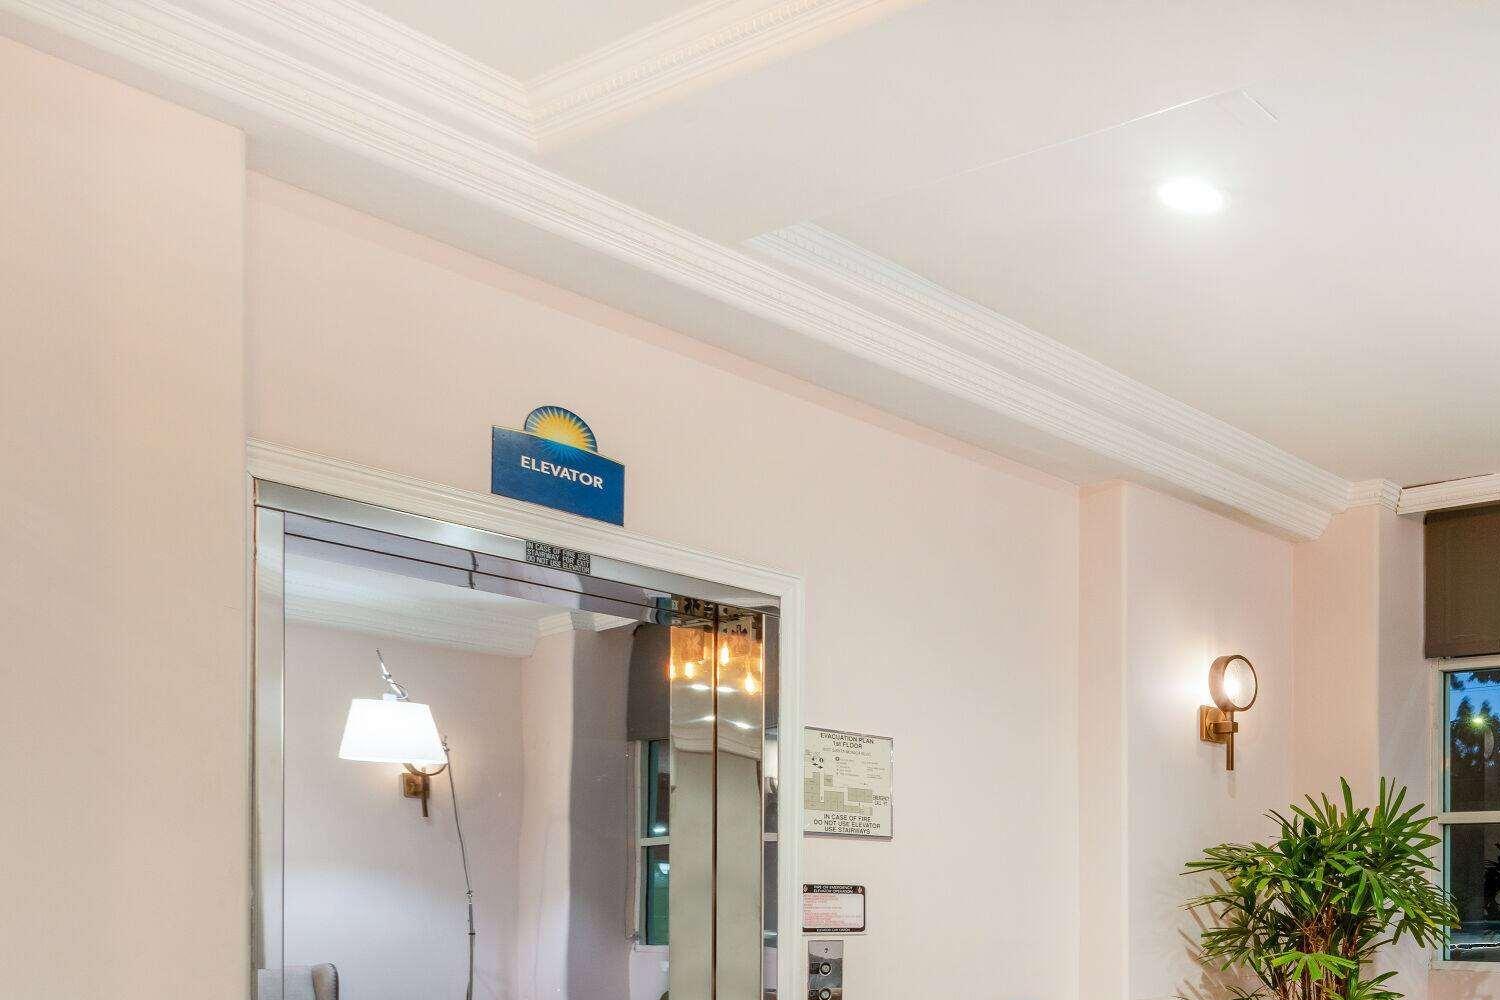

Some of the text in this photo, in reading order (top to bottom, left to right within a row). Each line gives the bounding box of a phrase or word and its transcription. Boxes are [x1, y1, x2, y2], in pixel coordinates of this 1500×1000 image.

[521, 455, 604, 490] ELEVATOR
[535, 543, 551, 553] CASE
[821, 732, 857, 742] EVACUATION
